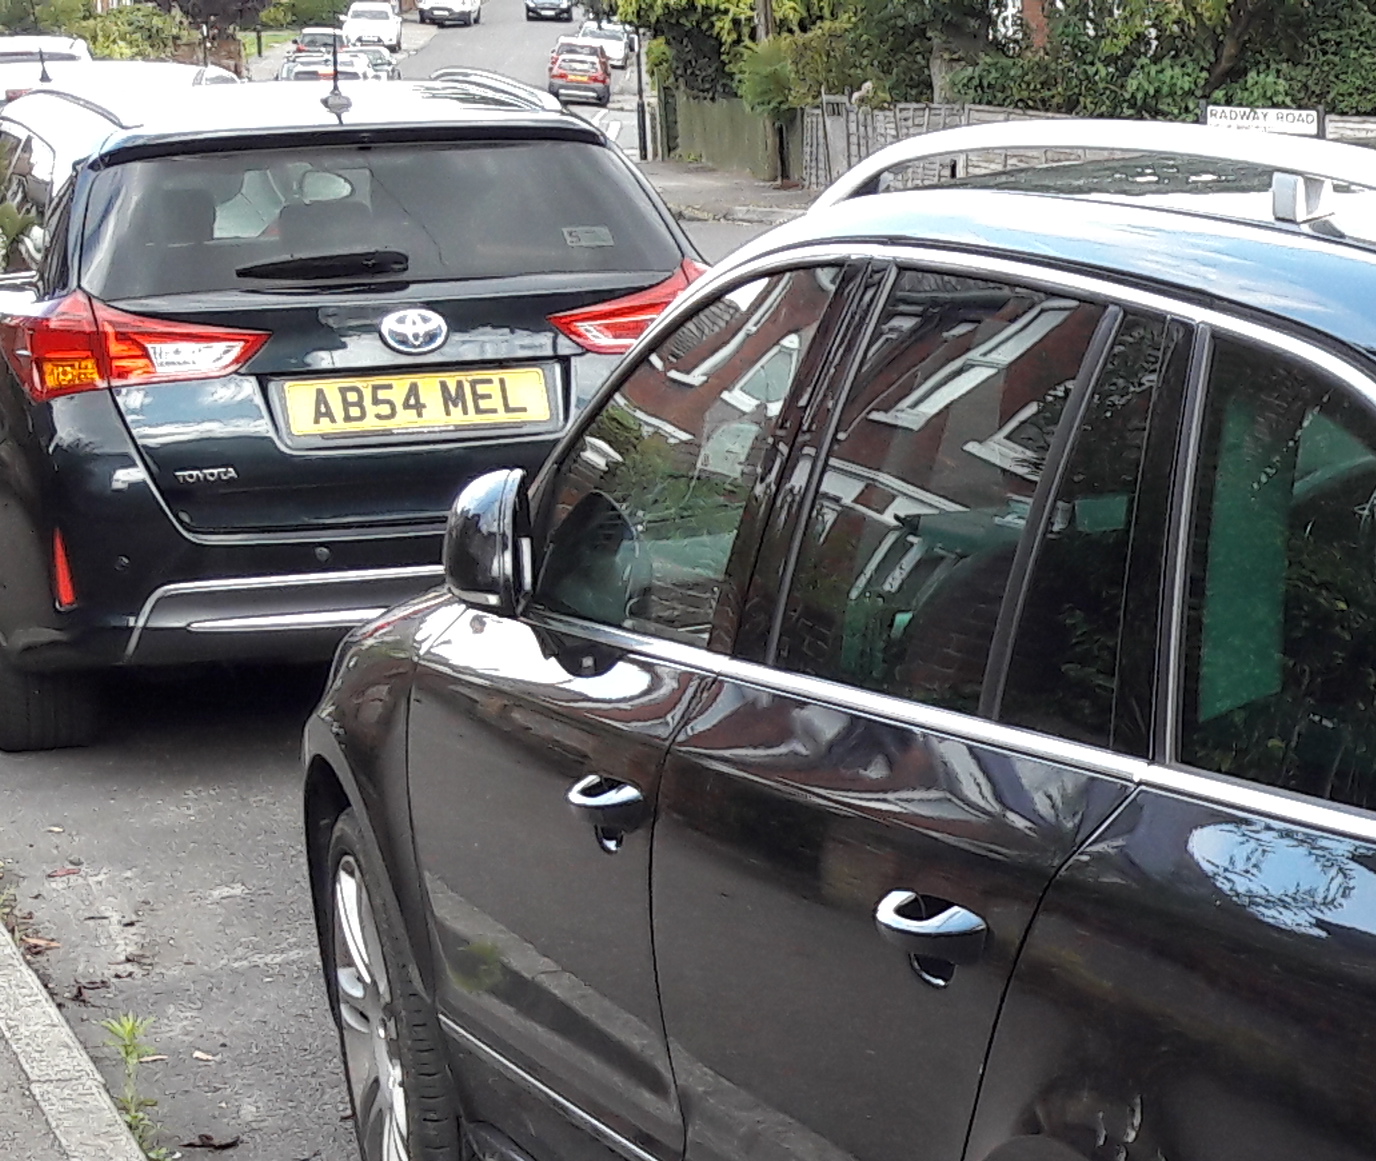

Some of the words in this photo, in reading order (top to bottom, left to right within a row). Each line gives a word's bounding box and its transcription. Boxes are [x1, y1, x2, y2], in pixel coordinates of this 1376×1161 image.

[1209, 109, 1268, 121] RADWAY
[1276, 111, 1315, 124] ROAD
[313, 381, 427, 424] AB54
[439, 377, 527, 416] MEL
[174, 467, 239, 483] TOYOTA
